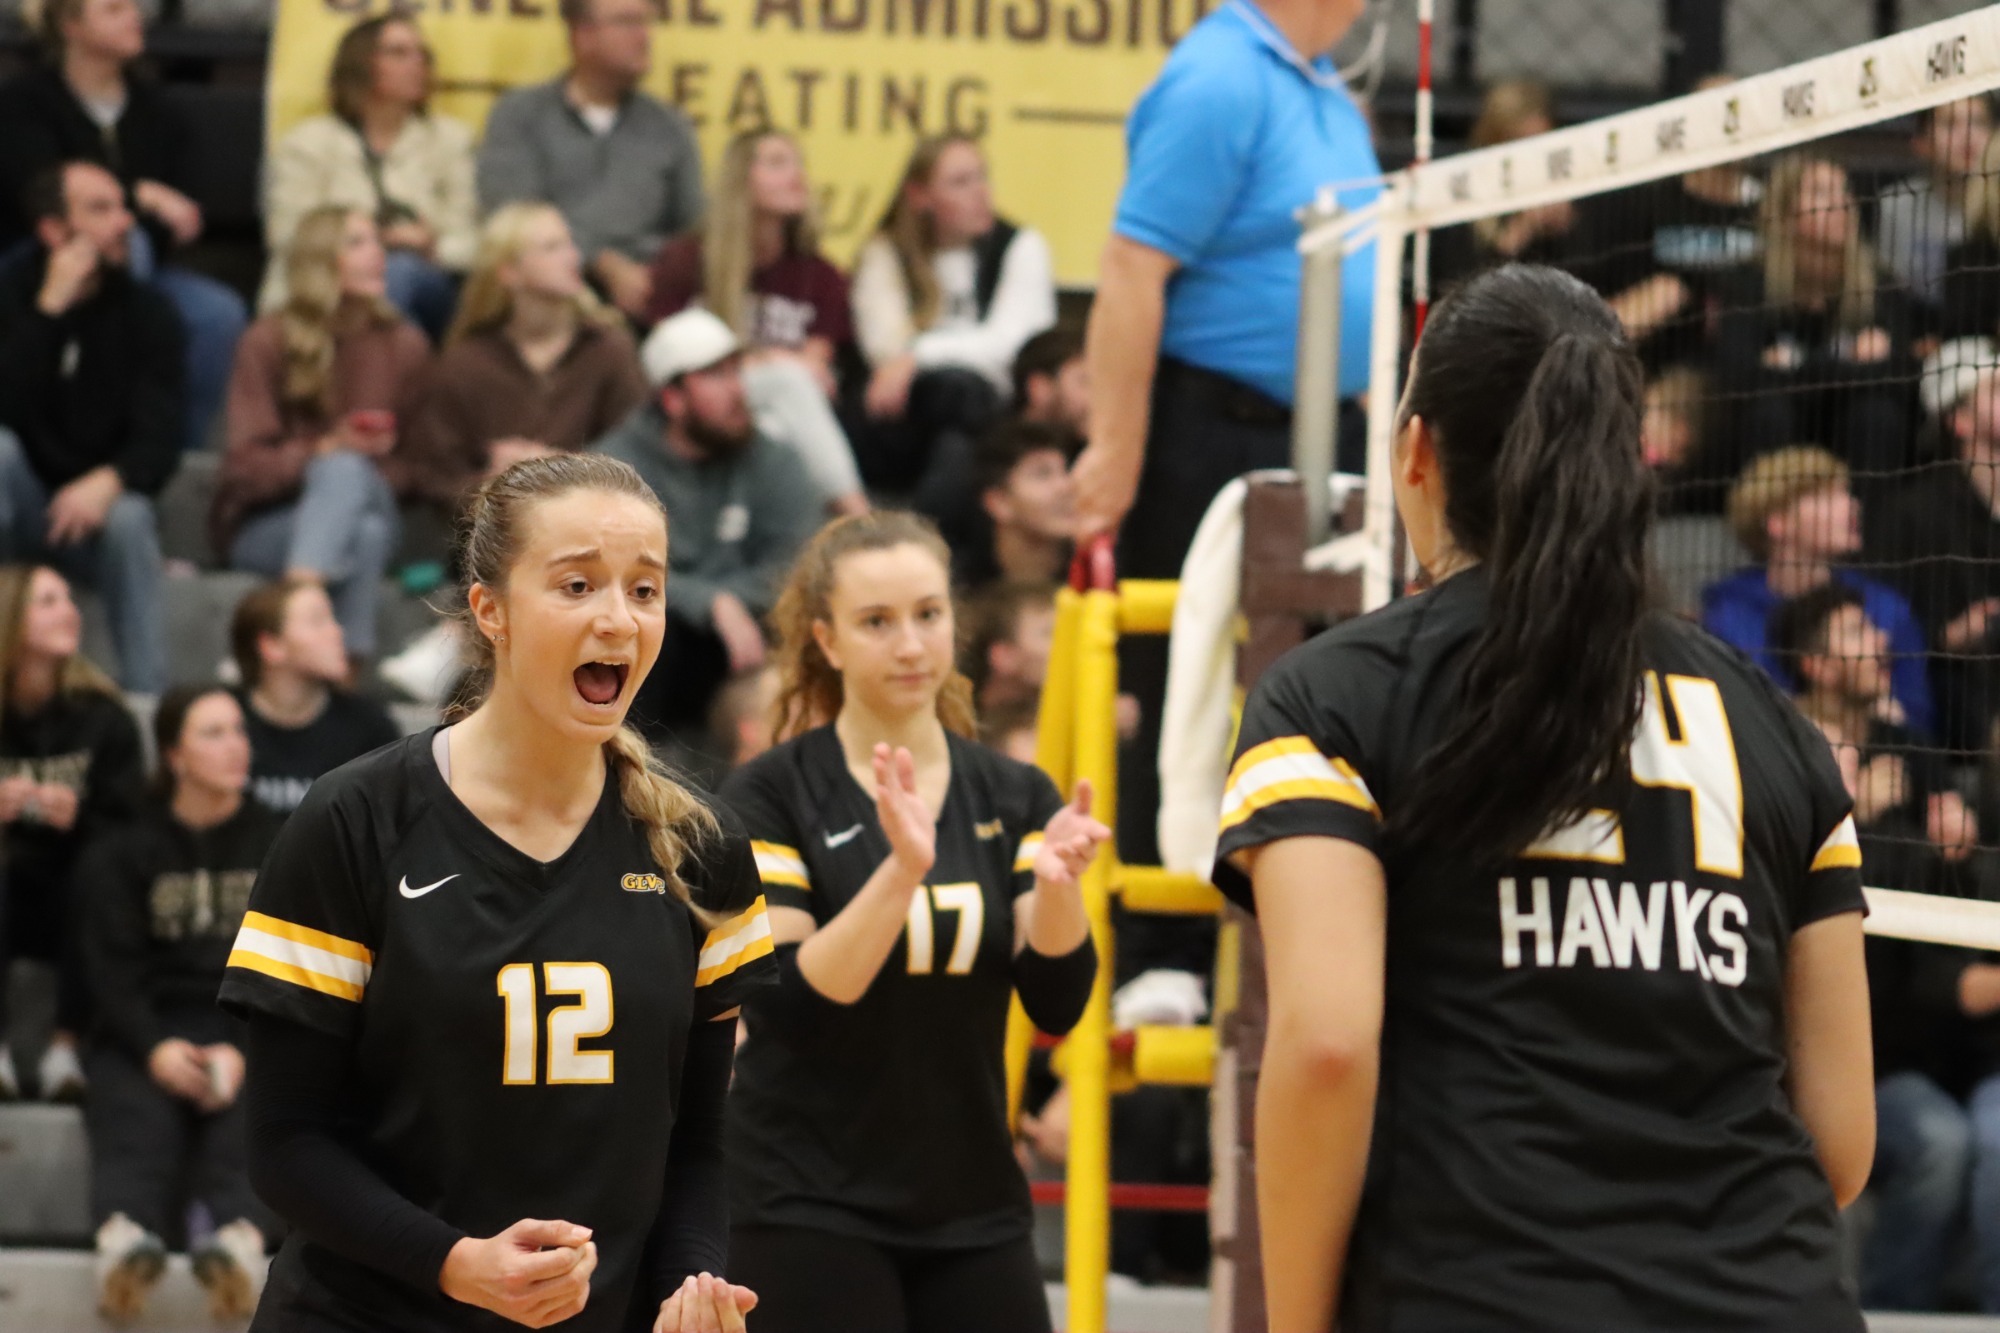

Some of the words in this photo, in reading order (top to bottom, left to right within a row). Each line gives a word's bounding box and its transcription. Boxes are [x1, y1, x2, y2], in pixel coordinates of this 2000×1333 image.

[673, 64, 988, 138] EATING
[907, 882, 984, 975] 17
[1499, 876, 1749, 987] HAWKS
[497, 962, 614, 1085] 12
